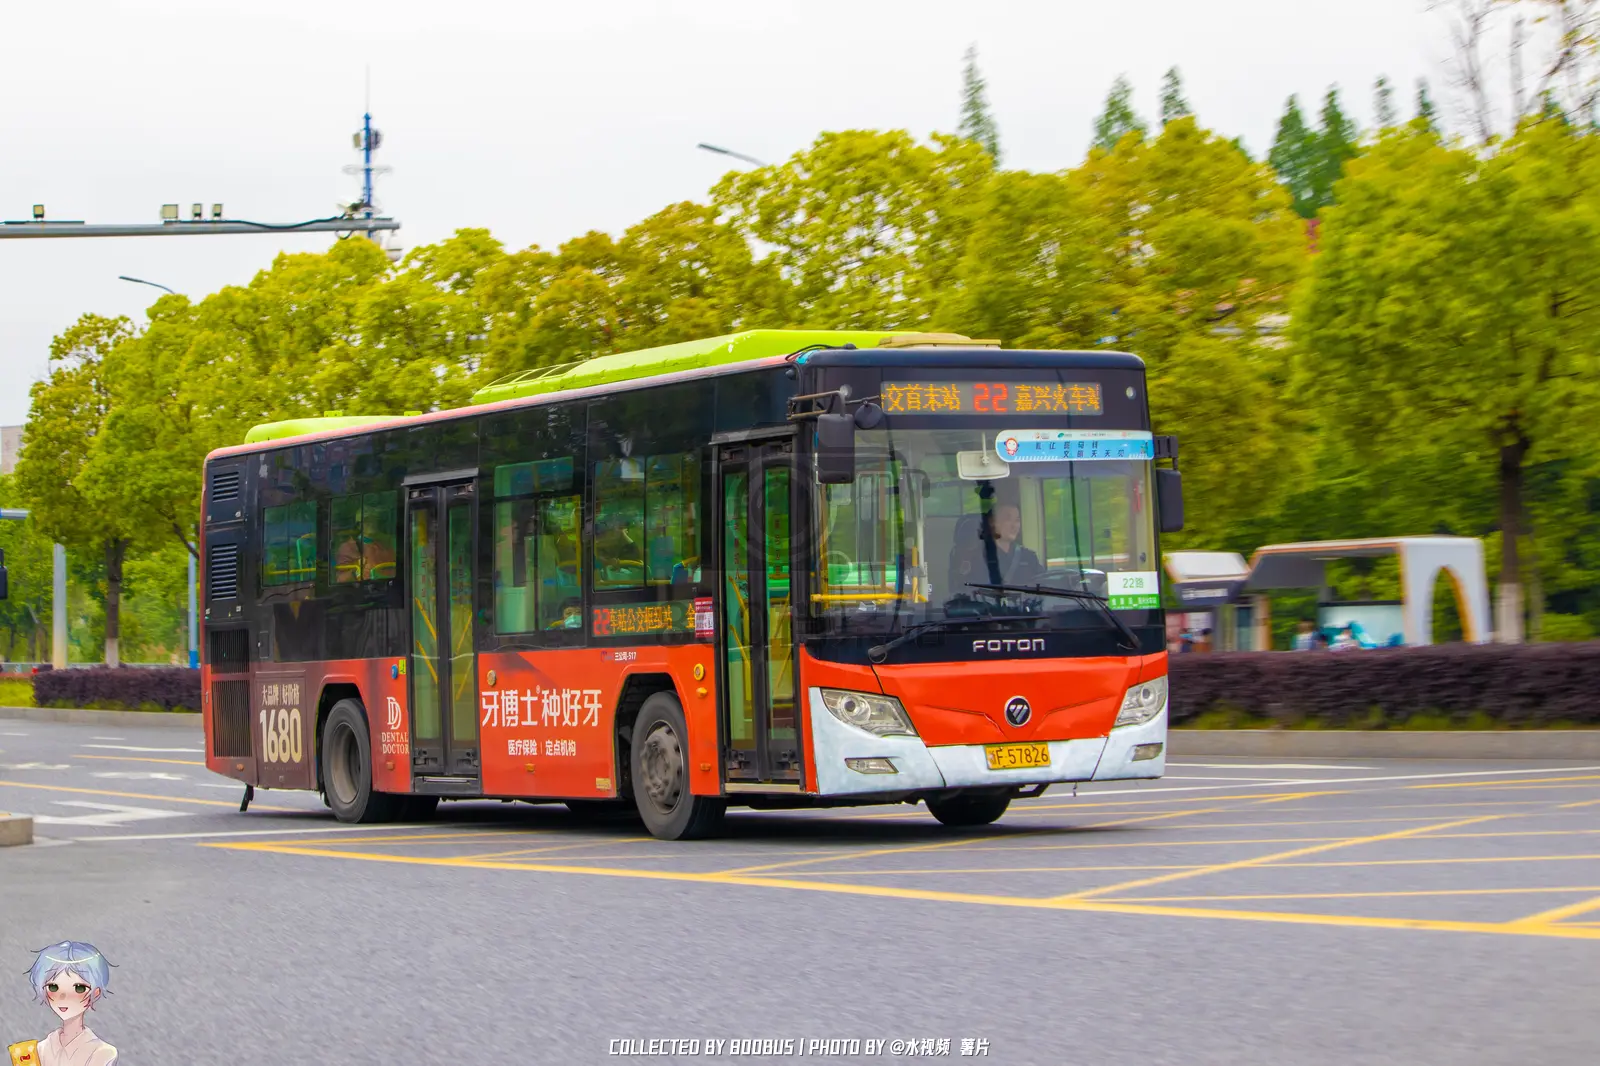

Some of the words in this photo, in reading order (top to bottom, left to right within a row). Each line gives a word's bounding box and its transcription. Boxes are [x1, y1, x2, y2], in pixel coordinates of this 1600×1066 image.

[972, 383, 1009, 412] 22
[1122, 577, 1144, 589] 22路
[593, 608, 611, 635] 22
[972, 638, 1046, 653] FOTON
[259, 708, 303, 763] 1680
[382, 732, 409, 742] DENTAL
[382, 743, 410, 754] DOCTOR
[507, 739, 538, 756] 医疗保险
[545, 739, 577, 756] 定点机构
